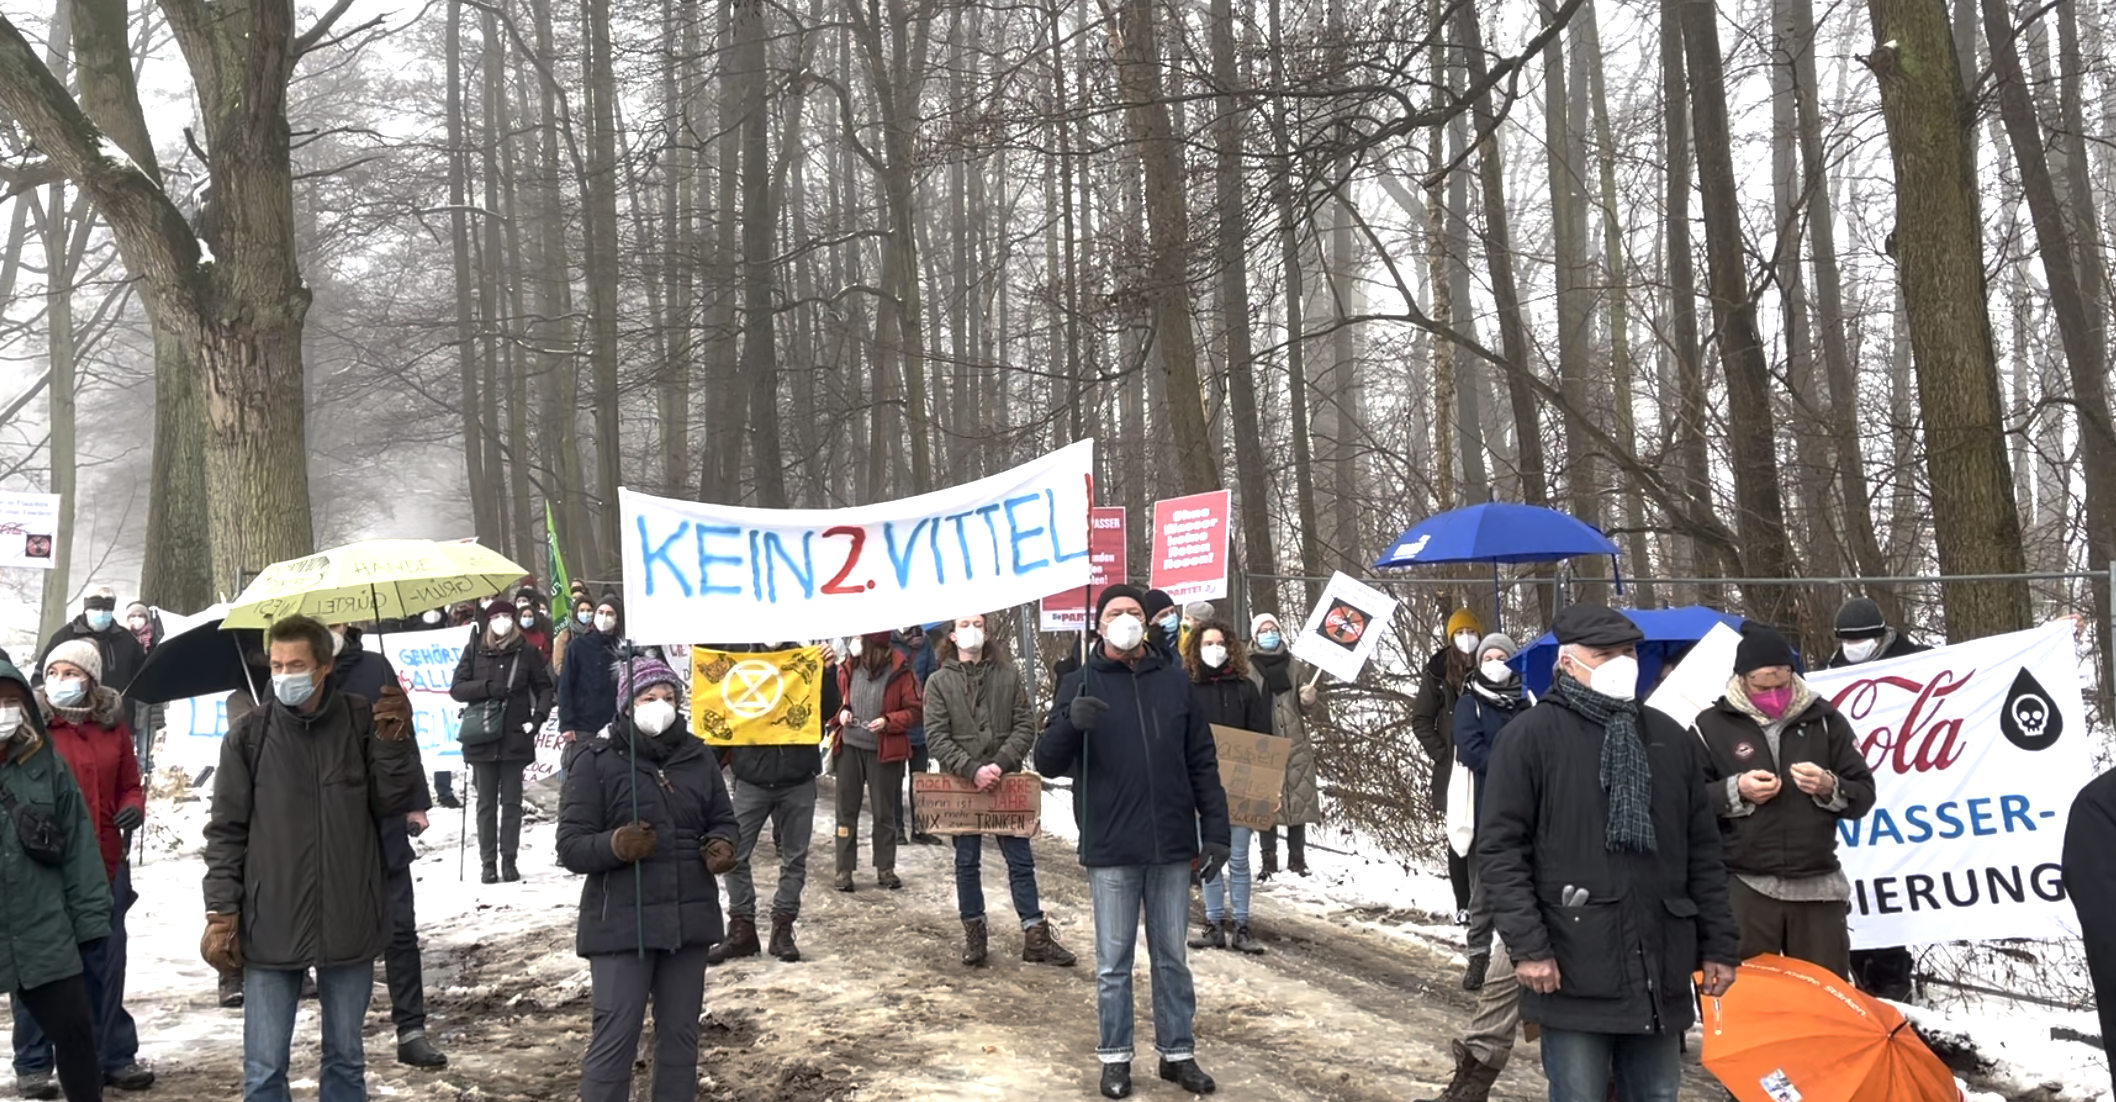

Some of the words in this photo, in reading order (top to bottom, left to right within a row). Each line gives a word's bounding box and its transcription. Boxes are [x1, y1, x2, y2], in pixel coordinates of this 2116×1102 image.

[1091, 518, 1120, 529] ASSER
[1173, 508, 1210, 522] Ohne
[1163, 518, 1218, 535] Wasser
[1167, 532, 1208, 547] keine
[637, 515, 814, 602] KEIN
[820, 526, 876, 594] 2.
[399, 643, 461, 667] GEHÖRT
[413, 669, 456, 689] ALL
[1217, 741, 1281, 766] asser
[915, 776, 951, 789] noch
[988, 794, 1027, 809] JAHR
[916, 813, 941, 829] NIX
[974, 813, 1025, 830] TRINKEN
[1847, 862, 2067, 917] IERUNG
